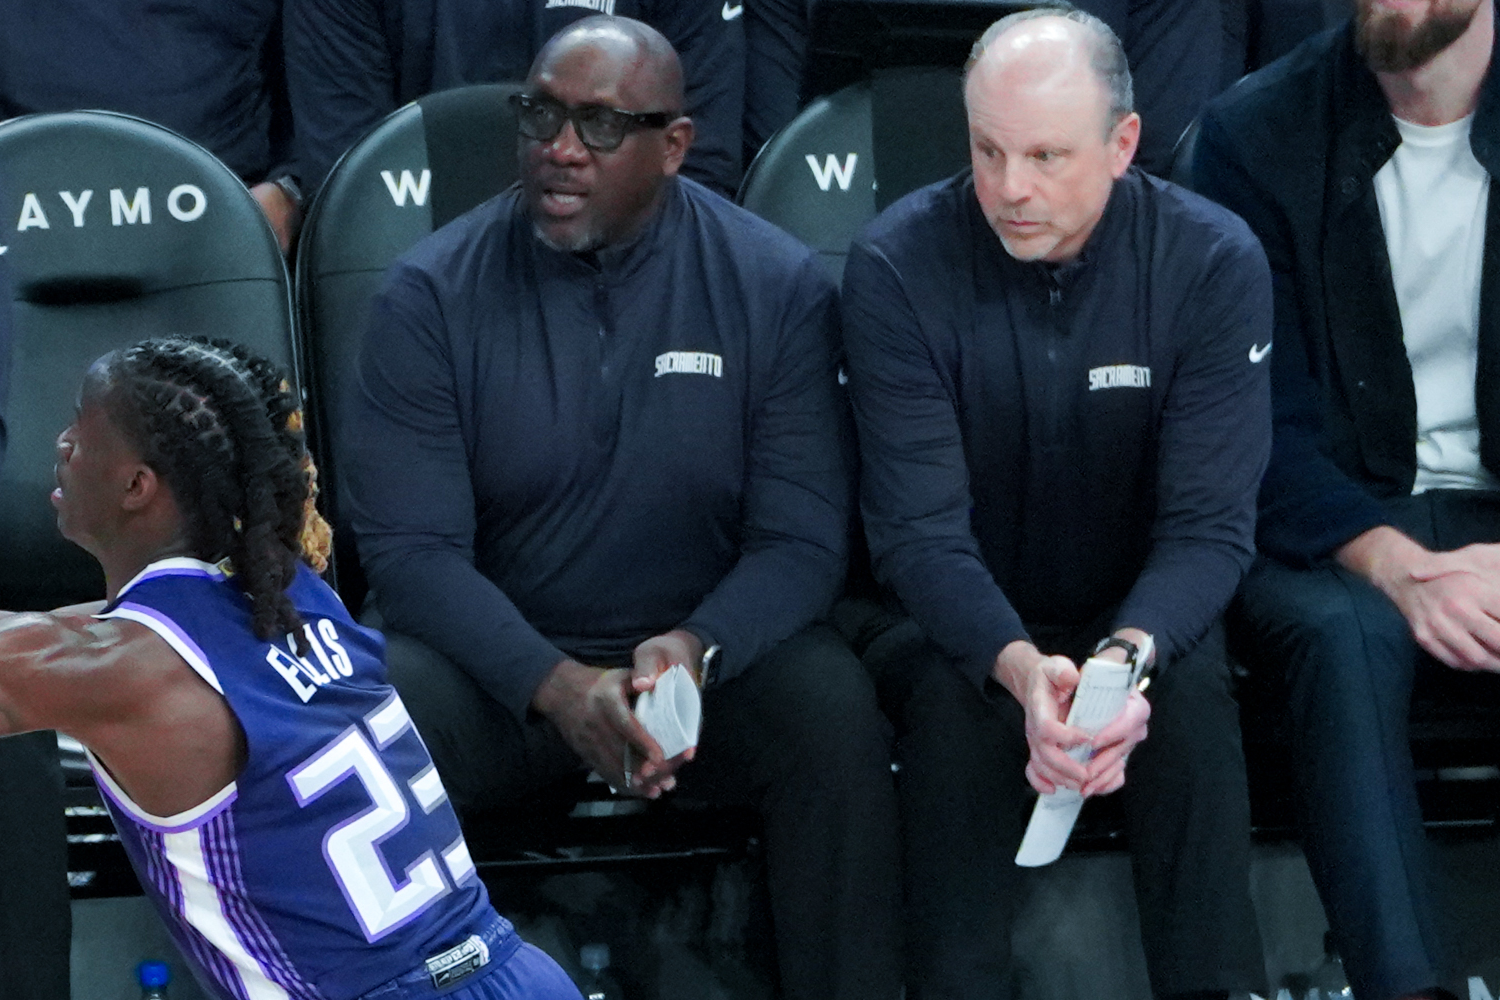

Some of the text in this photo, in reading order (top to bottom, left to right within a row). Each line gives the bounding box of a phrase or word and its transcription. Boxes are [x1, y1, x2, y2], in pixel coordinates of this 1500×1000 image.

[17, 184, 207, 231] AYMO
[654, 350, 724, 378] SACRAMENTO
[1088, 363, 1151, 391] SACRAMENT
